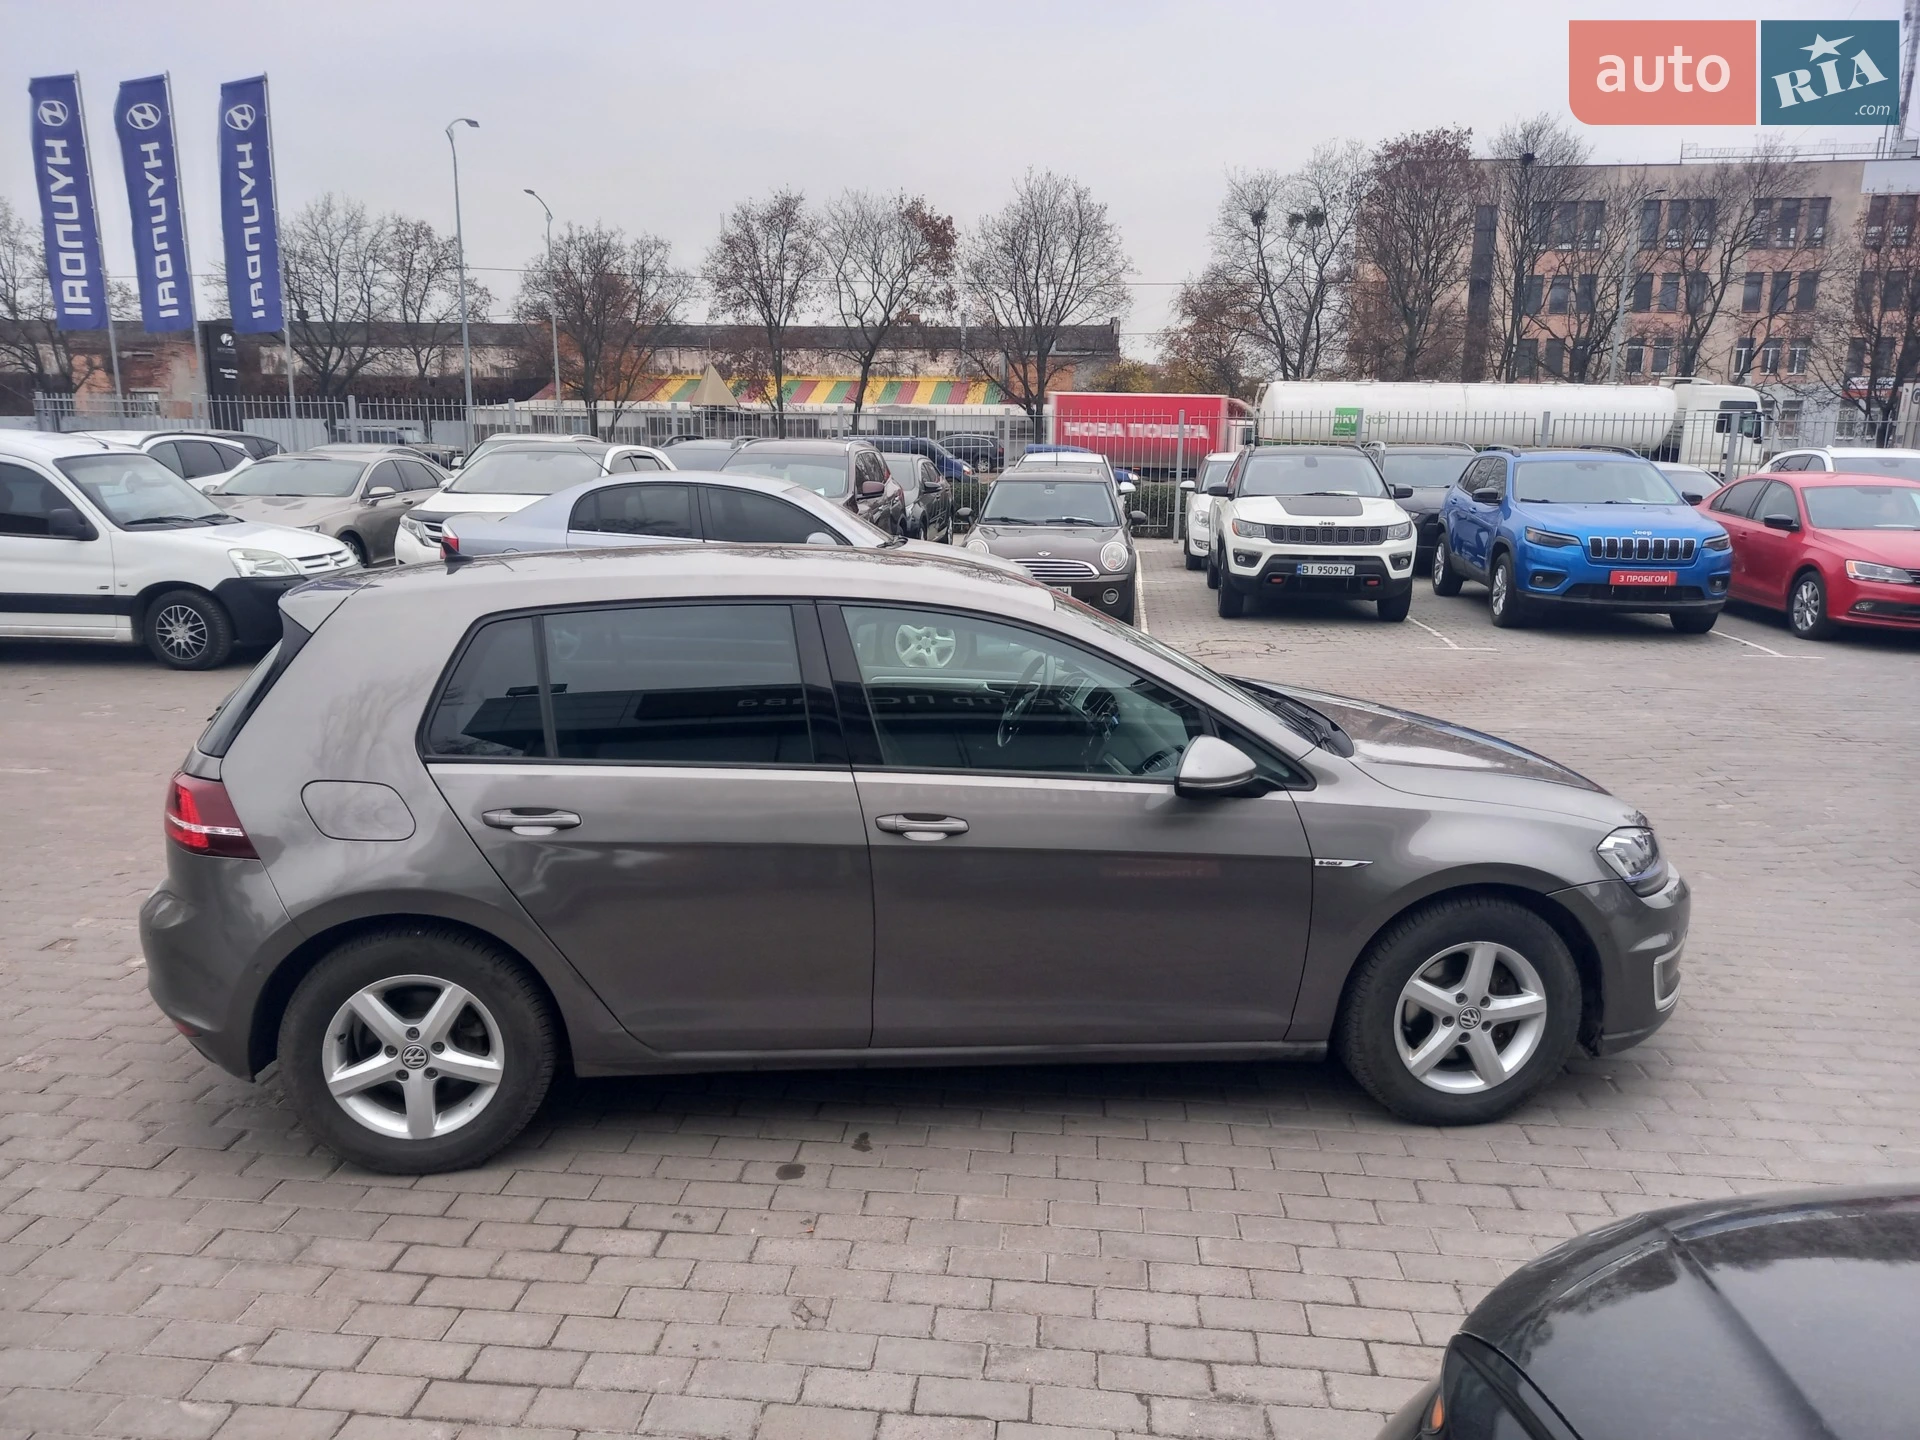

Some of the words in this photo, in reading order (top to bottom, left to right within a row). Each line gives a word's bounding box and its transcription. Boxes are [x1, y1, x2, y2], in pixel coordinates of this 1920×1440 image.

[1302, 565, 1314, 574] BI
[1317, 565, 1339, 575] 9509
[1340, 566, 1354, 575] HC
[1626, 575, 1668, 583] ПРОБІГОМ
